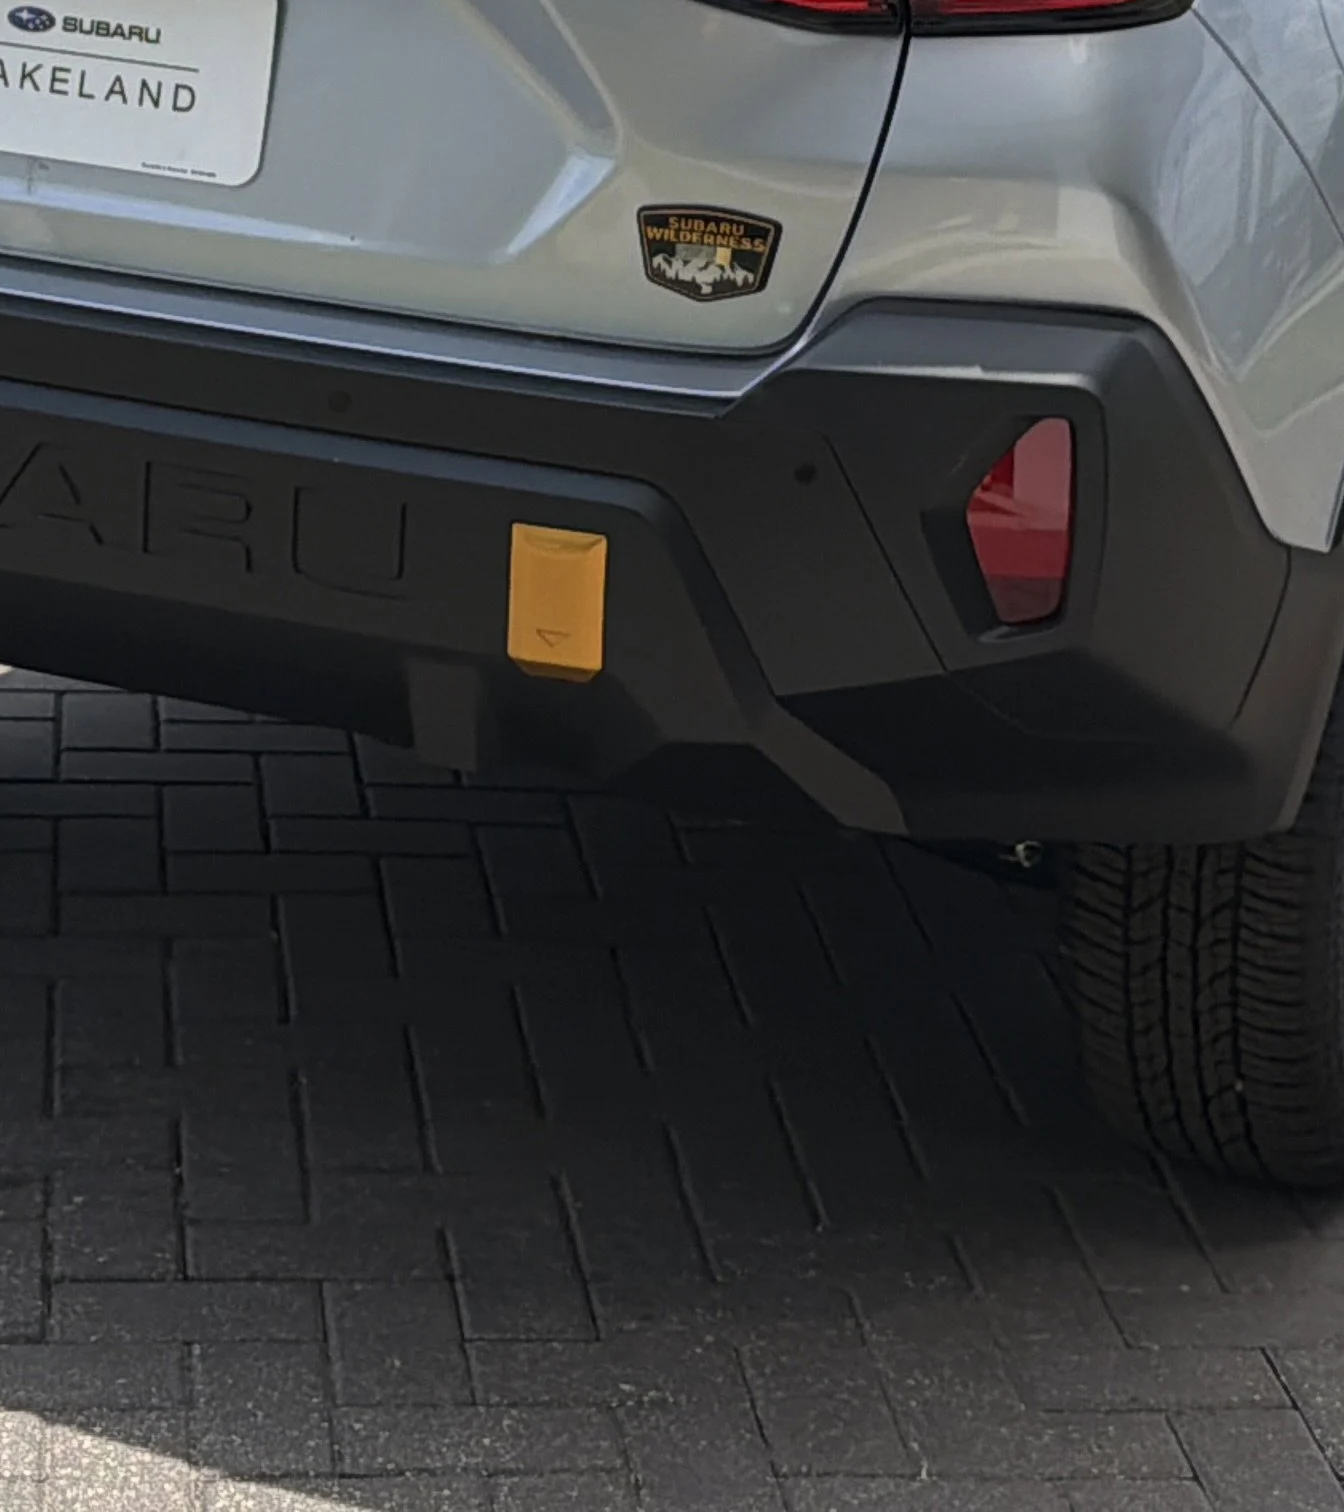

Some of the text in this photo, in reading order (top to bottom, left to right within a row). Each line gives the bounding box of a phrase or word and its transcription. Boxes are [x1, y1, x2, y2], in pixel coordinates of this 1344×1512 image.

[62, 16, 161, 44] SUBARU
[645, 225, 766, 253] WILDERNESS
[668, 216, 745, 236] SUBARU
